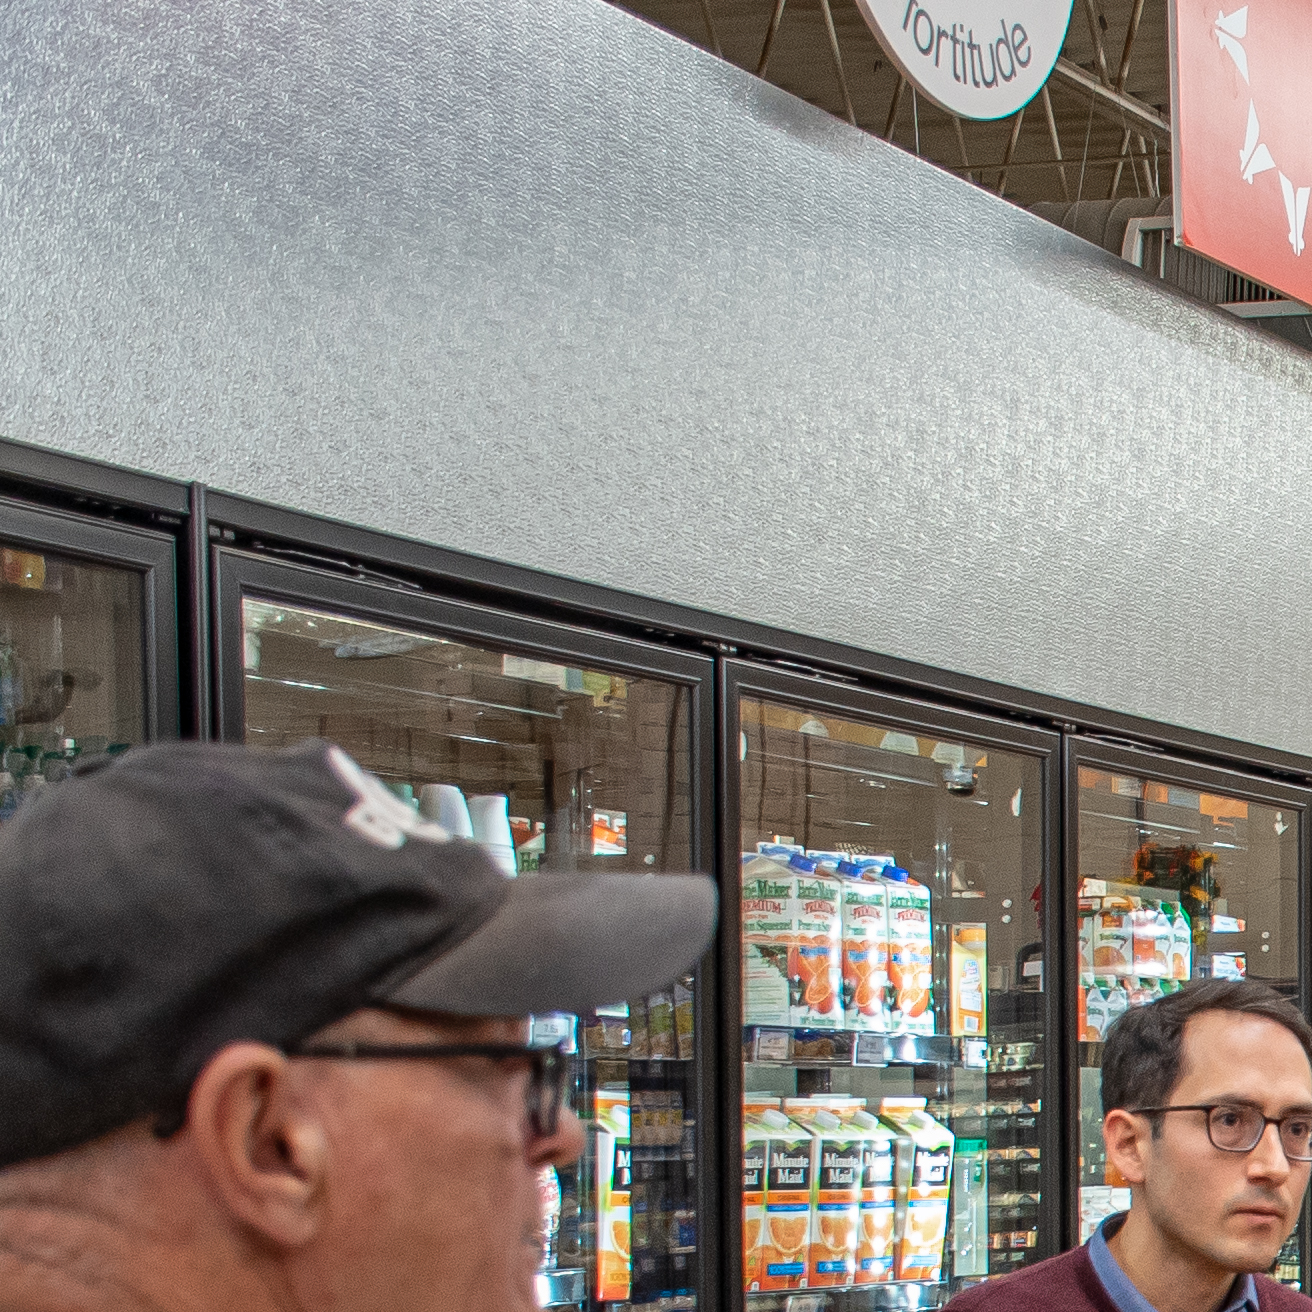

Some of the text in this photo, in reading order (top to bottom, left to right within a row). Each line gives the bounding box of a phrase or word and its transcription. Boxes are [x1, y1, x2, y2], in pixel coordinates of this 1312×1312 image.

[773, 1152, 809, 1168] Minute
[823, 1152, 860, 1168] Minute
[777, 1168, 805, 1184] Maid
[829, 1168, 854, 1184] Maid
